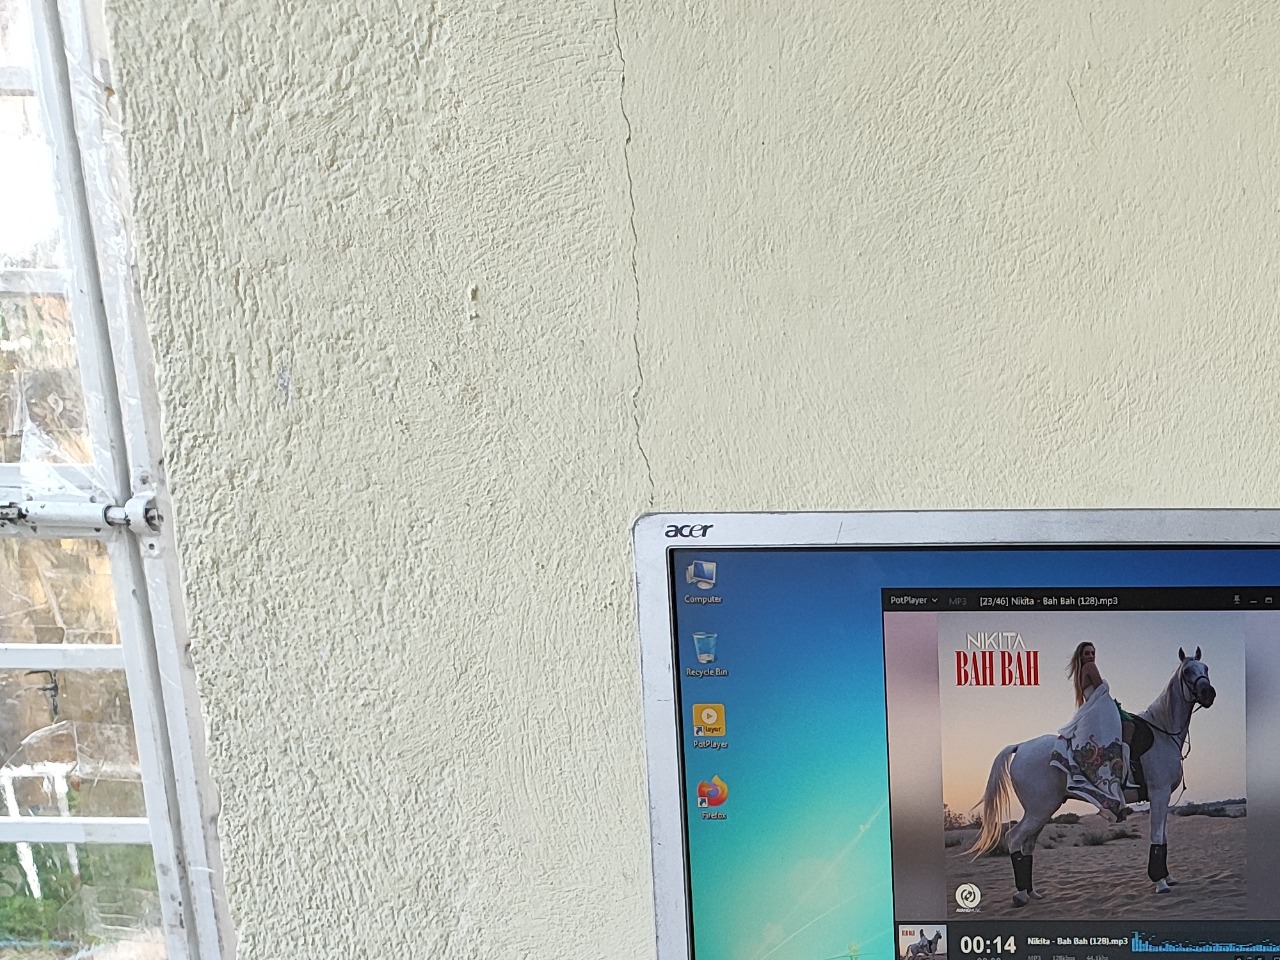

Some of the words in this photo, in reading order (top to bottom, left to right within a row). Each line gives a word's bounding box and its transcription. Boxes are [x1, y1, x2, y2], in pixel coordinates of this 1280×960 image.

[664, 524, 714, 538] acer
[684, 594, 723, 604] Computer
[890, 595, 928, 606] PotPlayer
[979, 596, 1009, 607] [23/46]
[1011, 596, 1035, 606] Nikita
[1042, 596, 1058, 606] Bah
[1060, 596, 1076, 606] Bah
[1077, 596, 1118, 608] (128).mp3
[966, 632, 1026, 650] NIKITA
[686, 667, 714, 678] Recycle
[715, 667, 728, 676] Bin
[955, 650, 995, 687] BAH
[999, 650, 1040, 687] BAH
[693, 740, 729, 750] PotPlayer
[702, 812, 728, 820] Firefox
[960, 935, 1017, 954] 00:14
[1027, 937, 1051, 946] Nikita
[1057, 937, 1073, 946] Bah
[1074, 937, 1089, 946] Bah
[1089, 937, 1129, 947] (128).mp3
